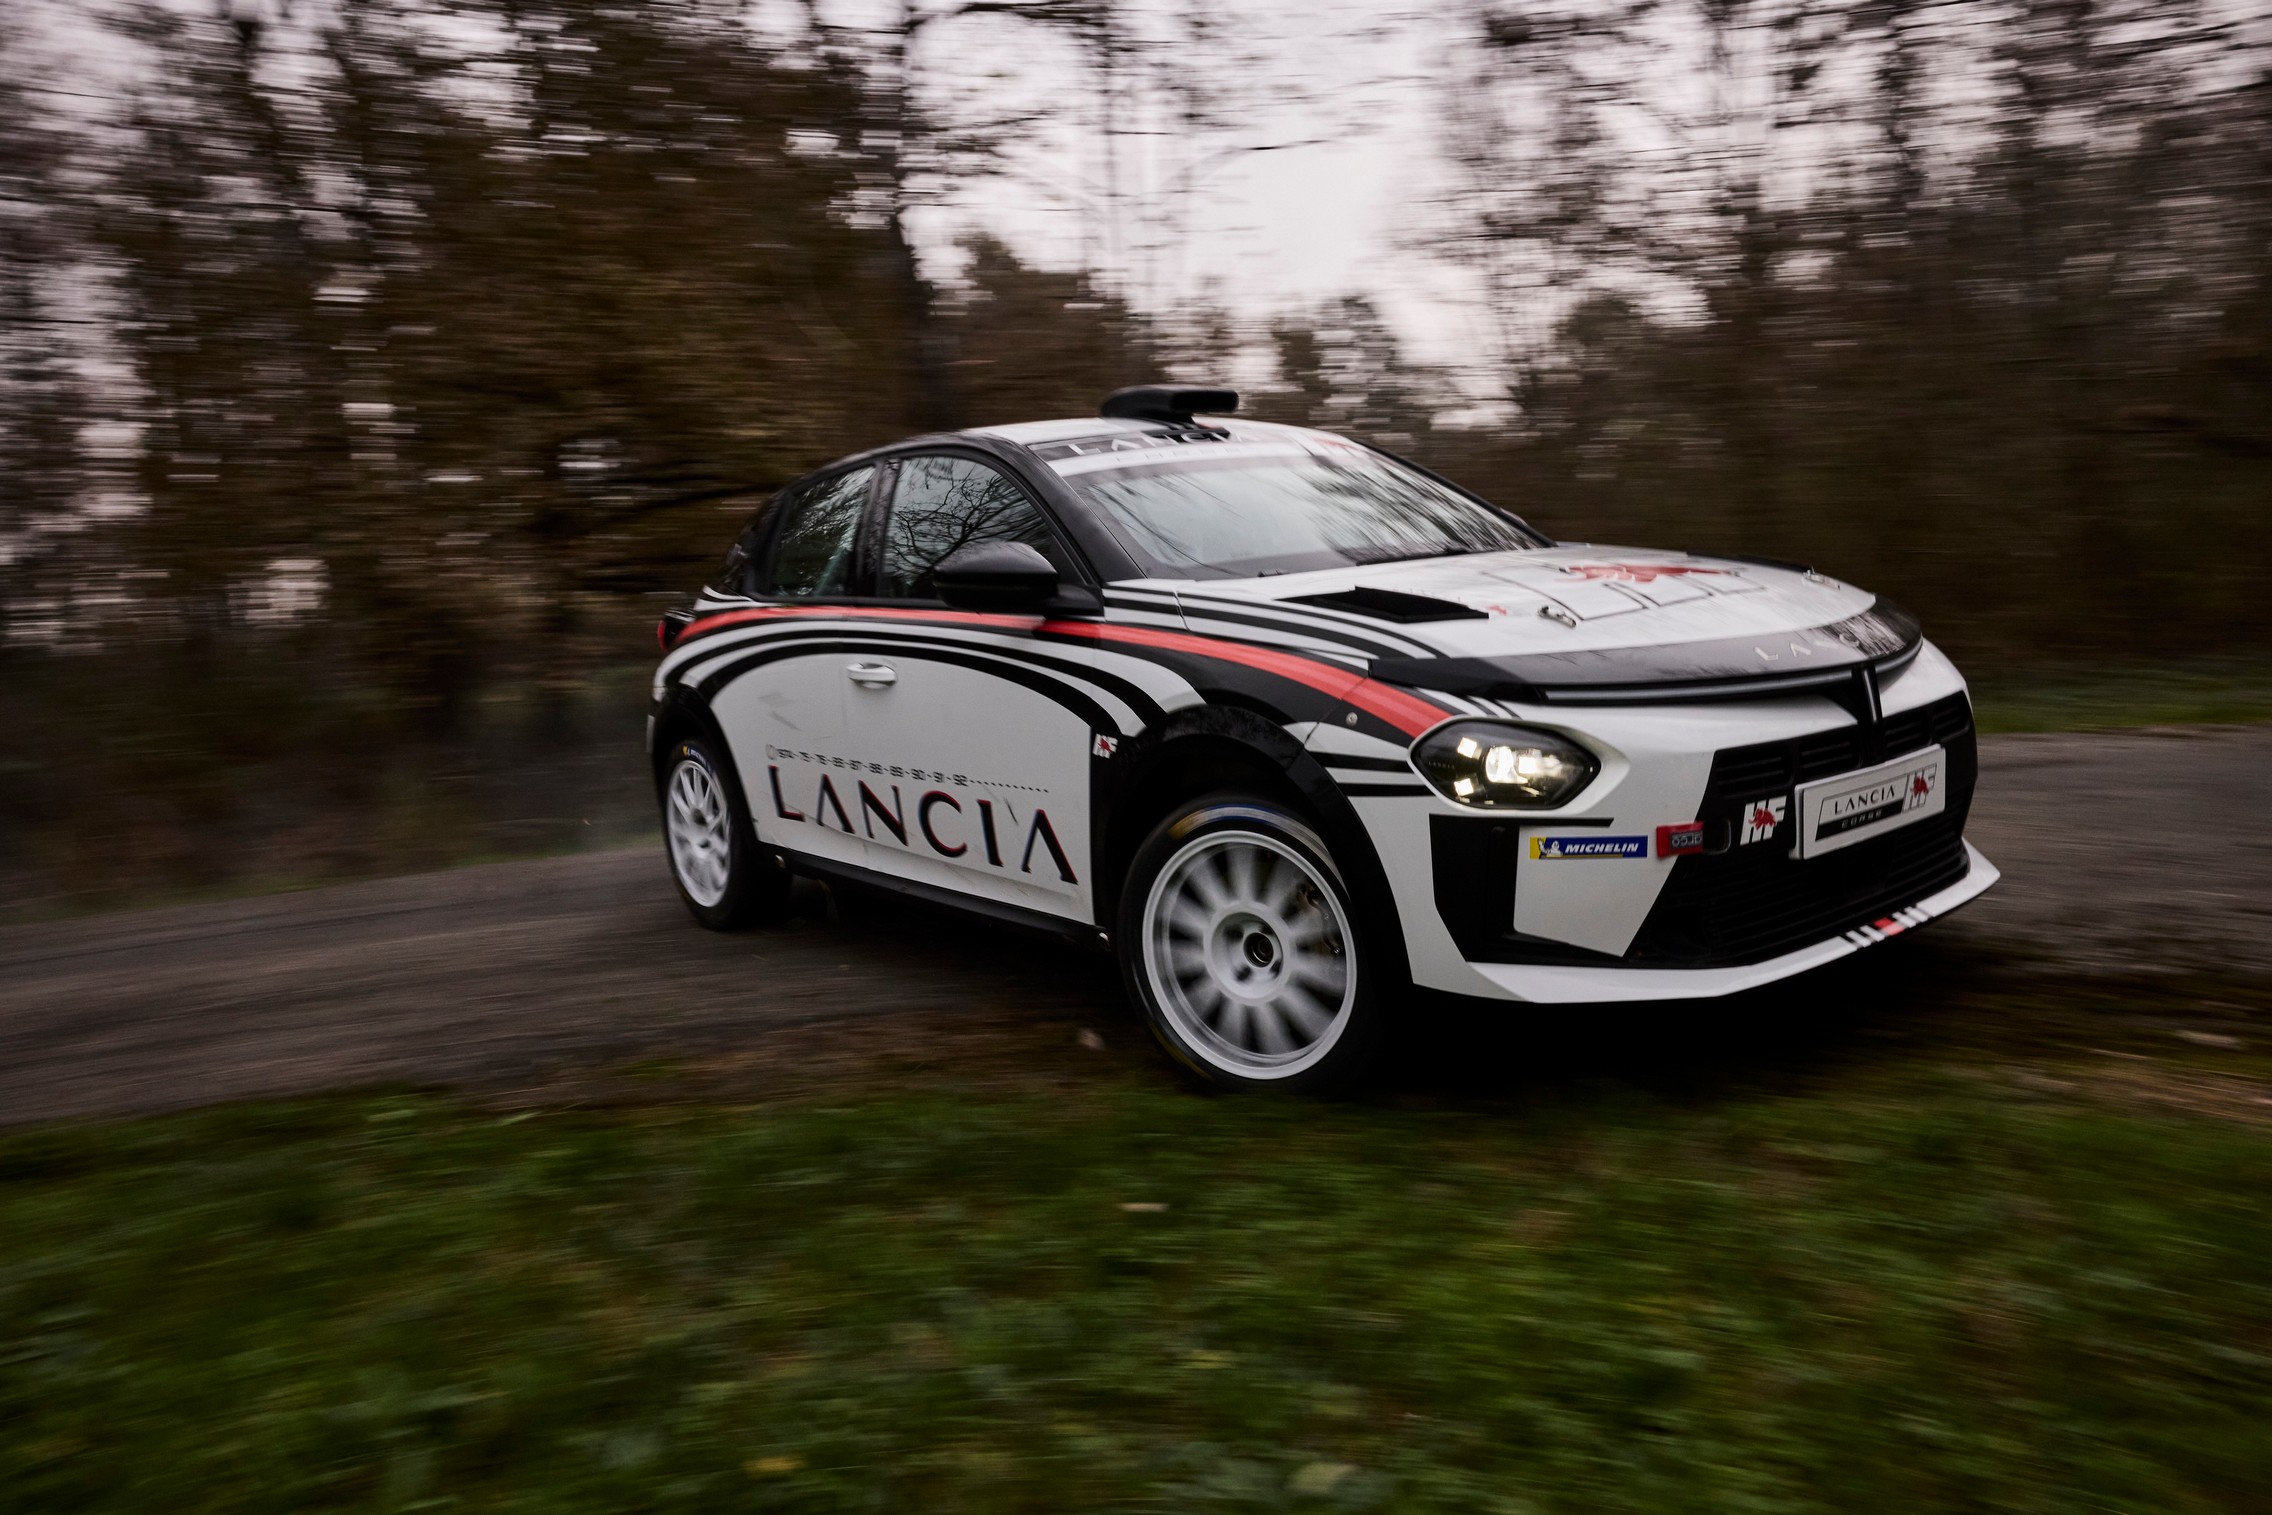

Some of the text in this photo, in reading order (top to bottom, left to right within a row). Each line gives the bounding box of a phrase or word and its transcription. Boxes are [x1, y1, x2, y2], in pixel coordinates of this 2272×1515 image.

[1834, 784, 1896, 815] LANCIA
[767, 764, 1079, 885] LANCIA
[1740, 795, 1787, 846] HF
[1564, 842, 1639, 854] MICHELIN
